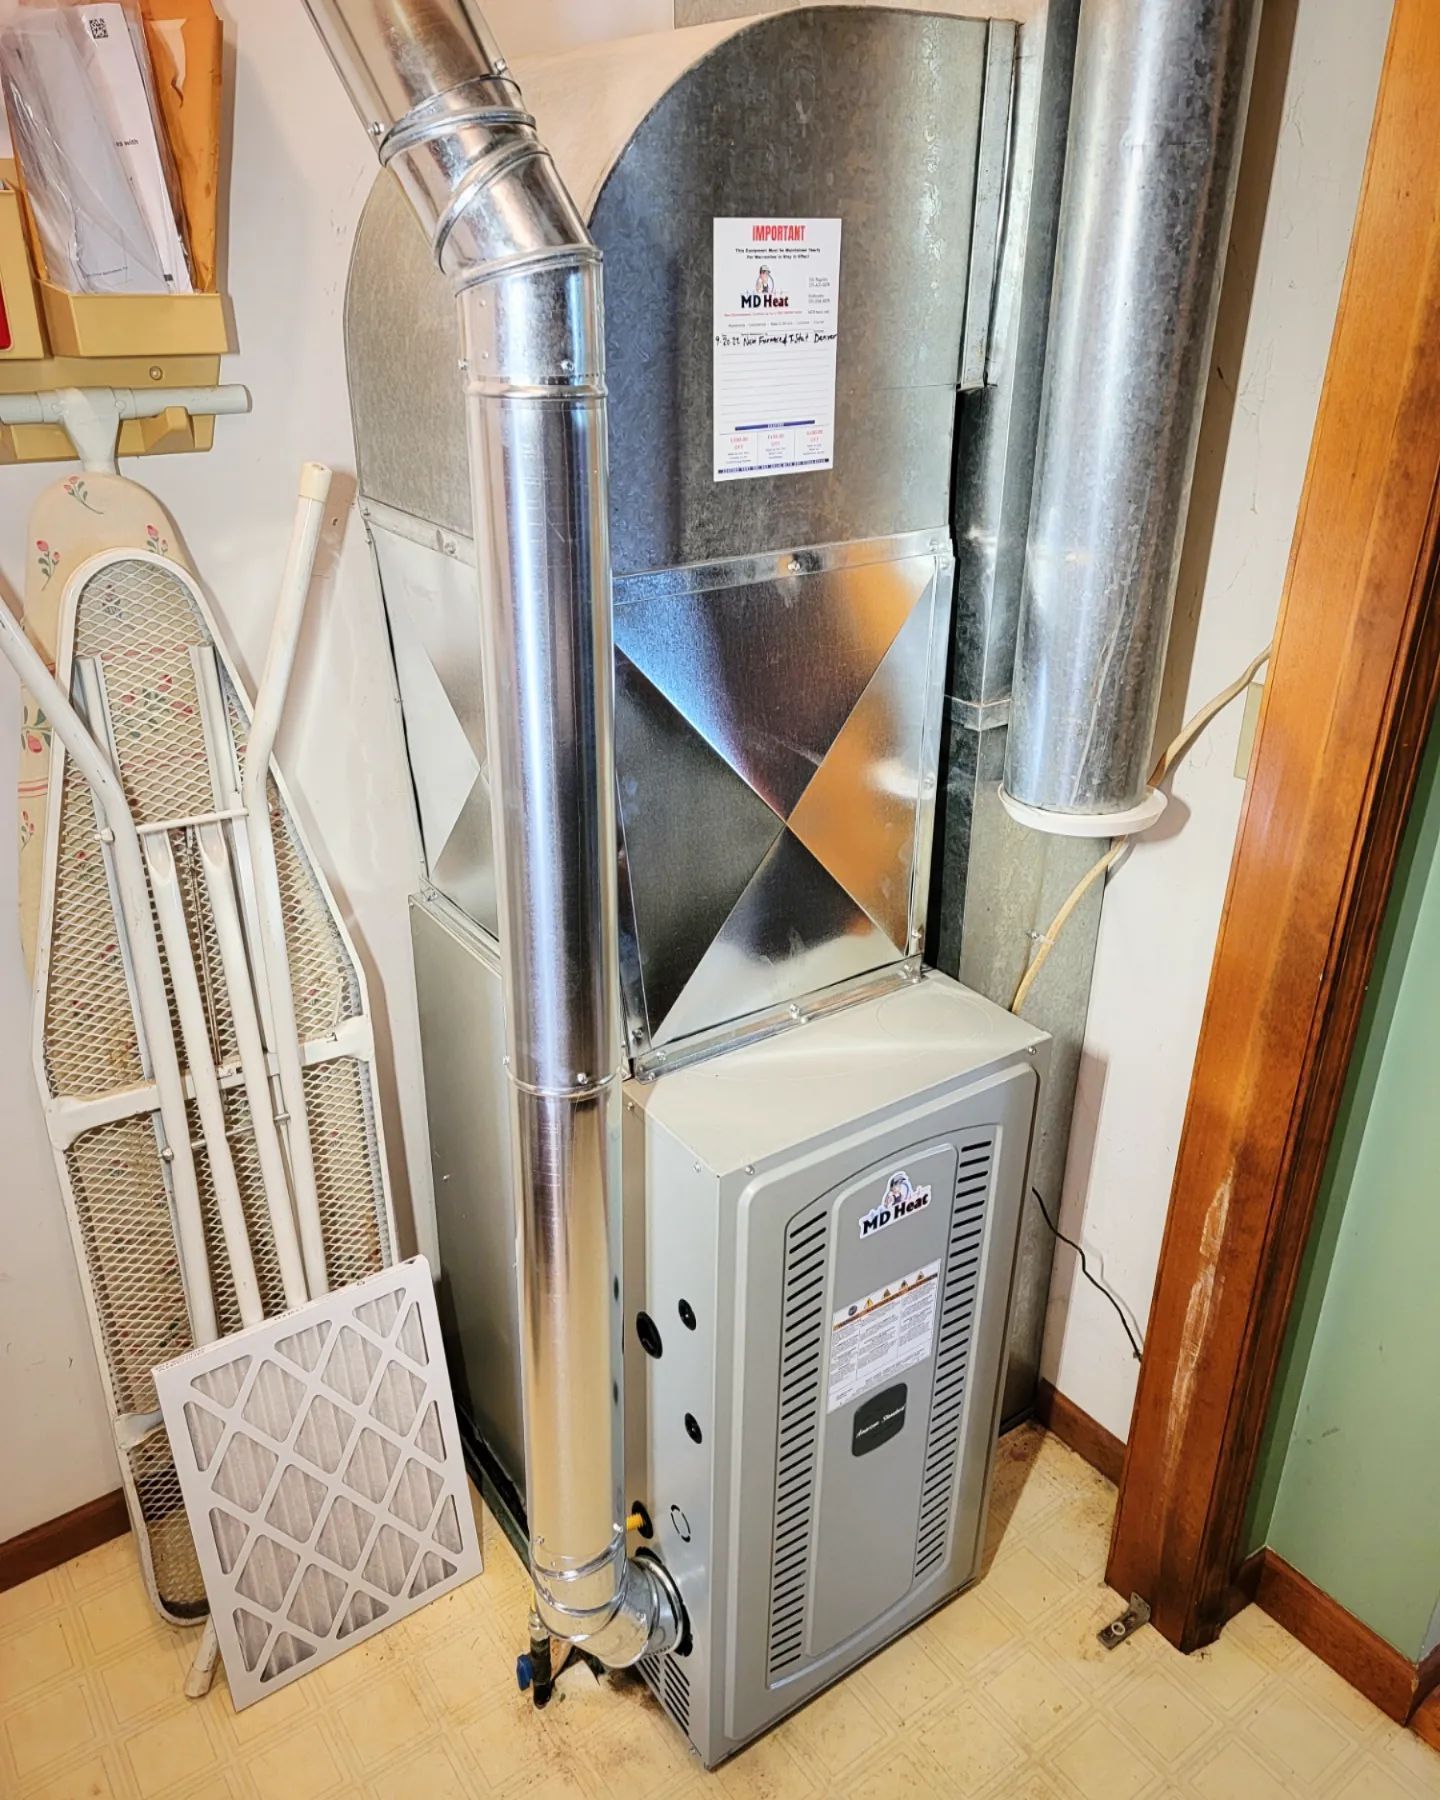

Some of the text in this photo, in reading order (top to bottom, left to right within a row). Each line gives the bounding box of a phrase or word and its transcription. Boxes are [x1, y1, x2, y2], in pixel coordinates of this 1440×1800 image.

[124, 138, 138, 146] with
[752, 224, 806, 242] IMPORTANT
[741, 295, 788, 308] MD Heat
[863, 1194, 928, 1234] MD Heat
[856, 1404, 906, 1439] American Standard
